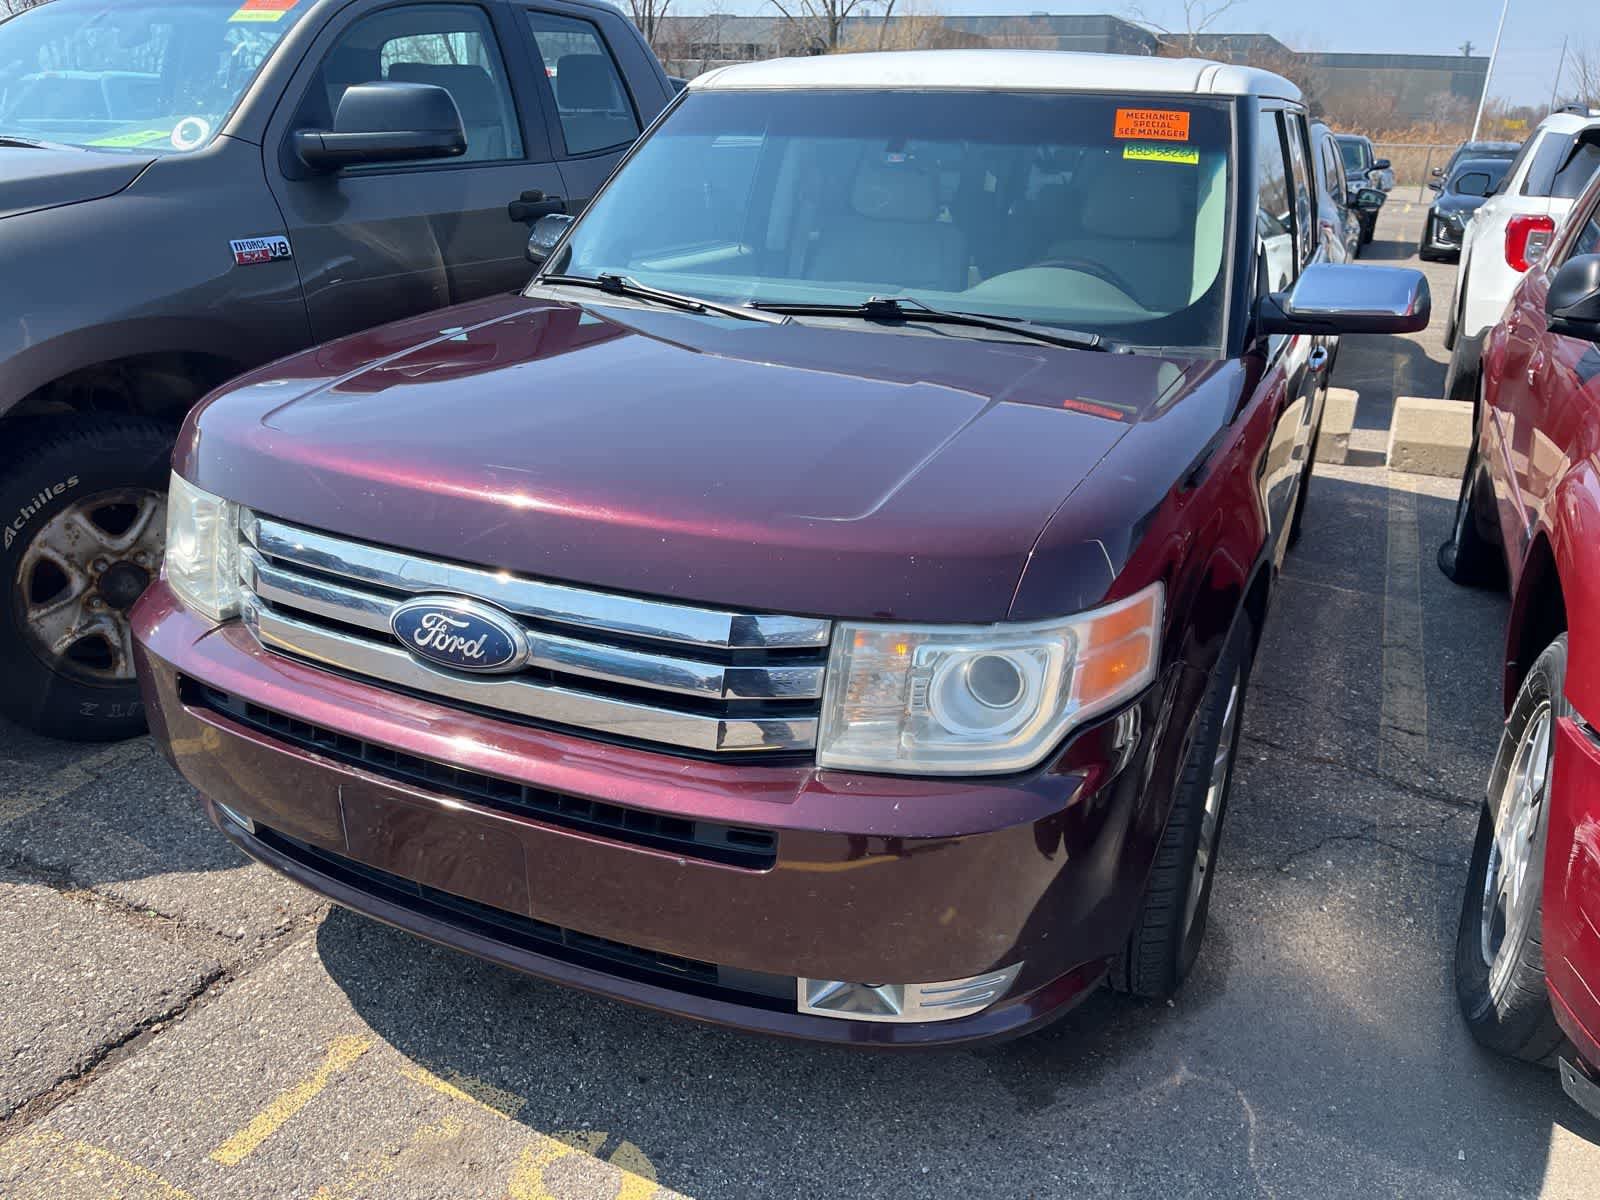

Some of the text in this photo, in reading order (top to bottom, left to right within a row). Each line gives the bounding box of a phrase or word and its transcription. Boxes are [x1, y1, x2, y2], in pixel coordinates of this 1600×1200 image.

[1126, 112, 1181, 121] MECHANICS
[1133, 120, 1172, 129] SPECIAL
[1119, 127, 1185, 137] SEE MANAGER
[4, 474, 80, 550] Achilles
[414, 613, 488, 658] Ford
